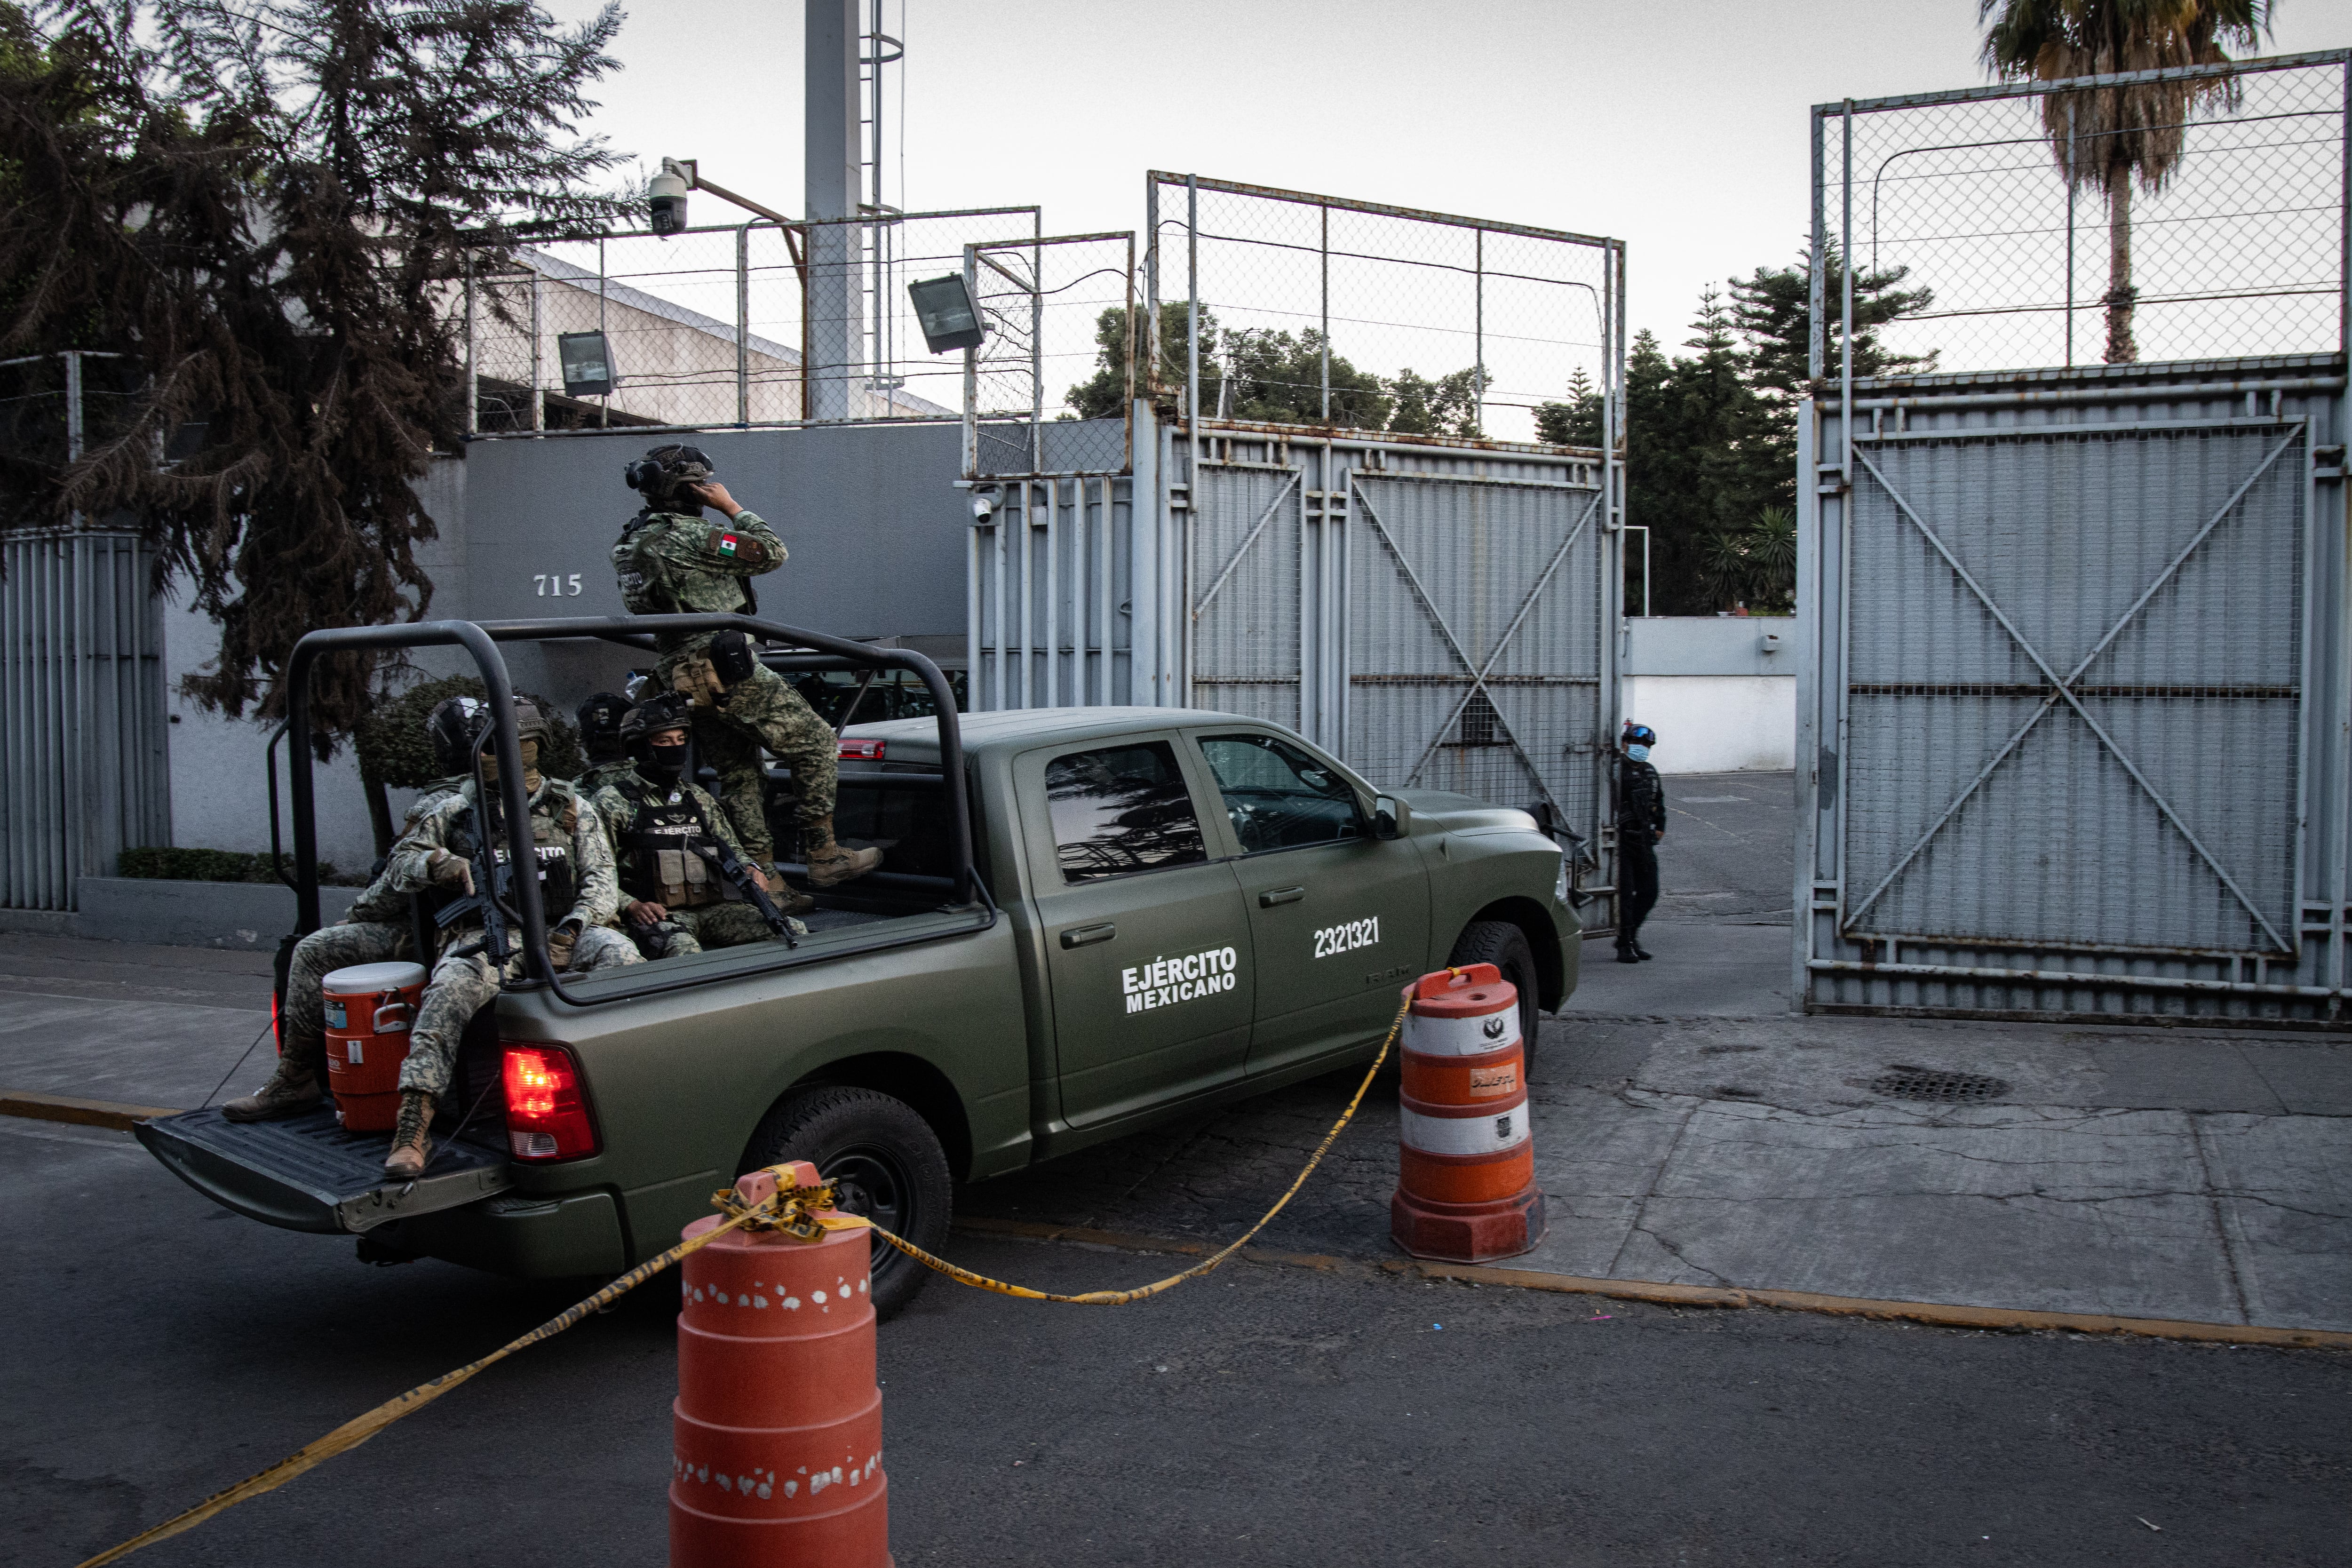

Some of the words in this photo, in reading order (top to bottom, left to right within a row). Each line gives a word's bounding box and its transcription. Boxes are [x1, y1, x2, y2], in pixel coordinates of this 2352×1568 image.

[533, 573, 582, 597] 715
[1314, 916, 1379, 958] 2321321
[1122, 947, 1237, 994] EJÉRCITO
[1126, 972, 1236, 1013] MEXICANO
